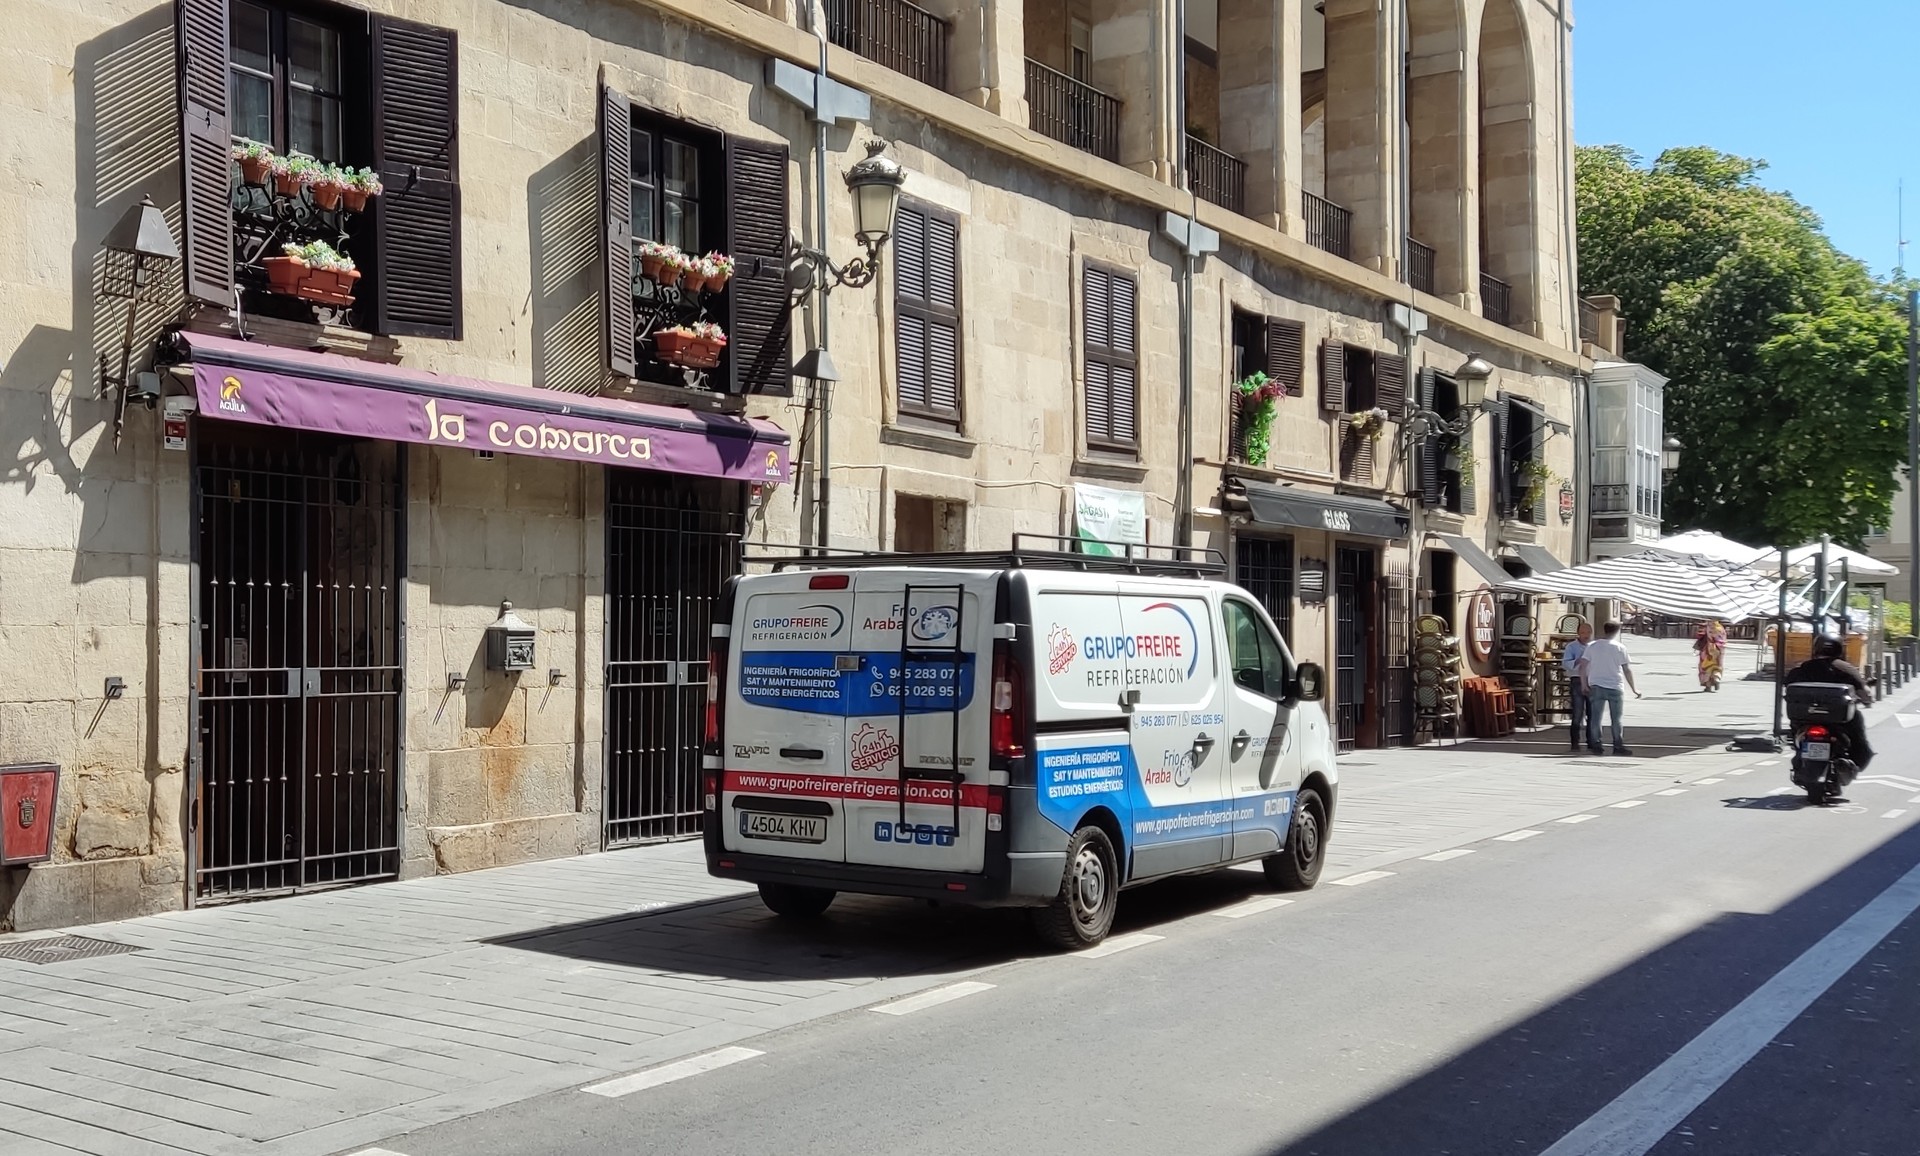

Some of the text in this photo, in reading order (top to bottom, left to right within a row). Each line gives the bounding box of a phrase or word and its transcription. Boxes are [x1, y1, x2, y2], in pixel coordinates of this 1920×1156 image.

[425, 399, 651, 460] la comarca
[892, 604, 917, 617] Fro
[753, 618, 829, 629] GRUPOFREIRE
[752, 631, 827, 640] REFRIGERACIÓN
[1084, 635, 1182, 659] GRUPOFREIRE
[744, 666, 841, 677] INGENIERÍA FRIGORÍFICA
[914, 668, 937, 679] 283
[1087, 664, 1184, 687] REFRIGERACIÓN
[746, 678, 836, 688] SAT Y MANTENIMIENTO
[742, 687, 840, 698] ESTUDIOS ENERGÉTICOS
[913, 686, 936, 696] 026
[1141, 715, 1177, 727] 945 283 077
[862, 740, 881, 755] 24h
[852, 745, 899, 770] SERVICIO
[1082, 749, 1120, 764] FRIGORÍFICA
[1053, 765, 1123, 782] SAT Y MANTENIMIENTO
[1145, 768, 1171, 785] Araba
[739, 775, 963, 799] www.grupofreirerefrigeraion.com
[1049, 779, 1124, 798] ESTUDIOS ENERGÉTICOS
[751, 816, 817, 837] 4504 KHV
[1136, 808, 1254, 834] www.grupofreirerefrigeracion.com
